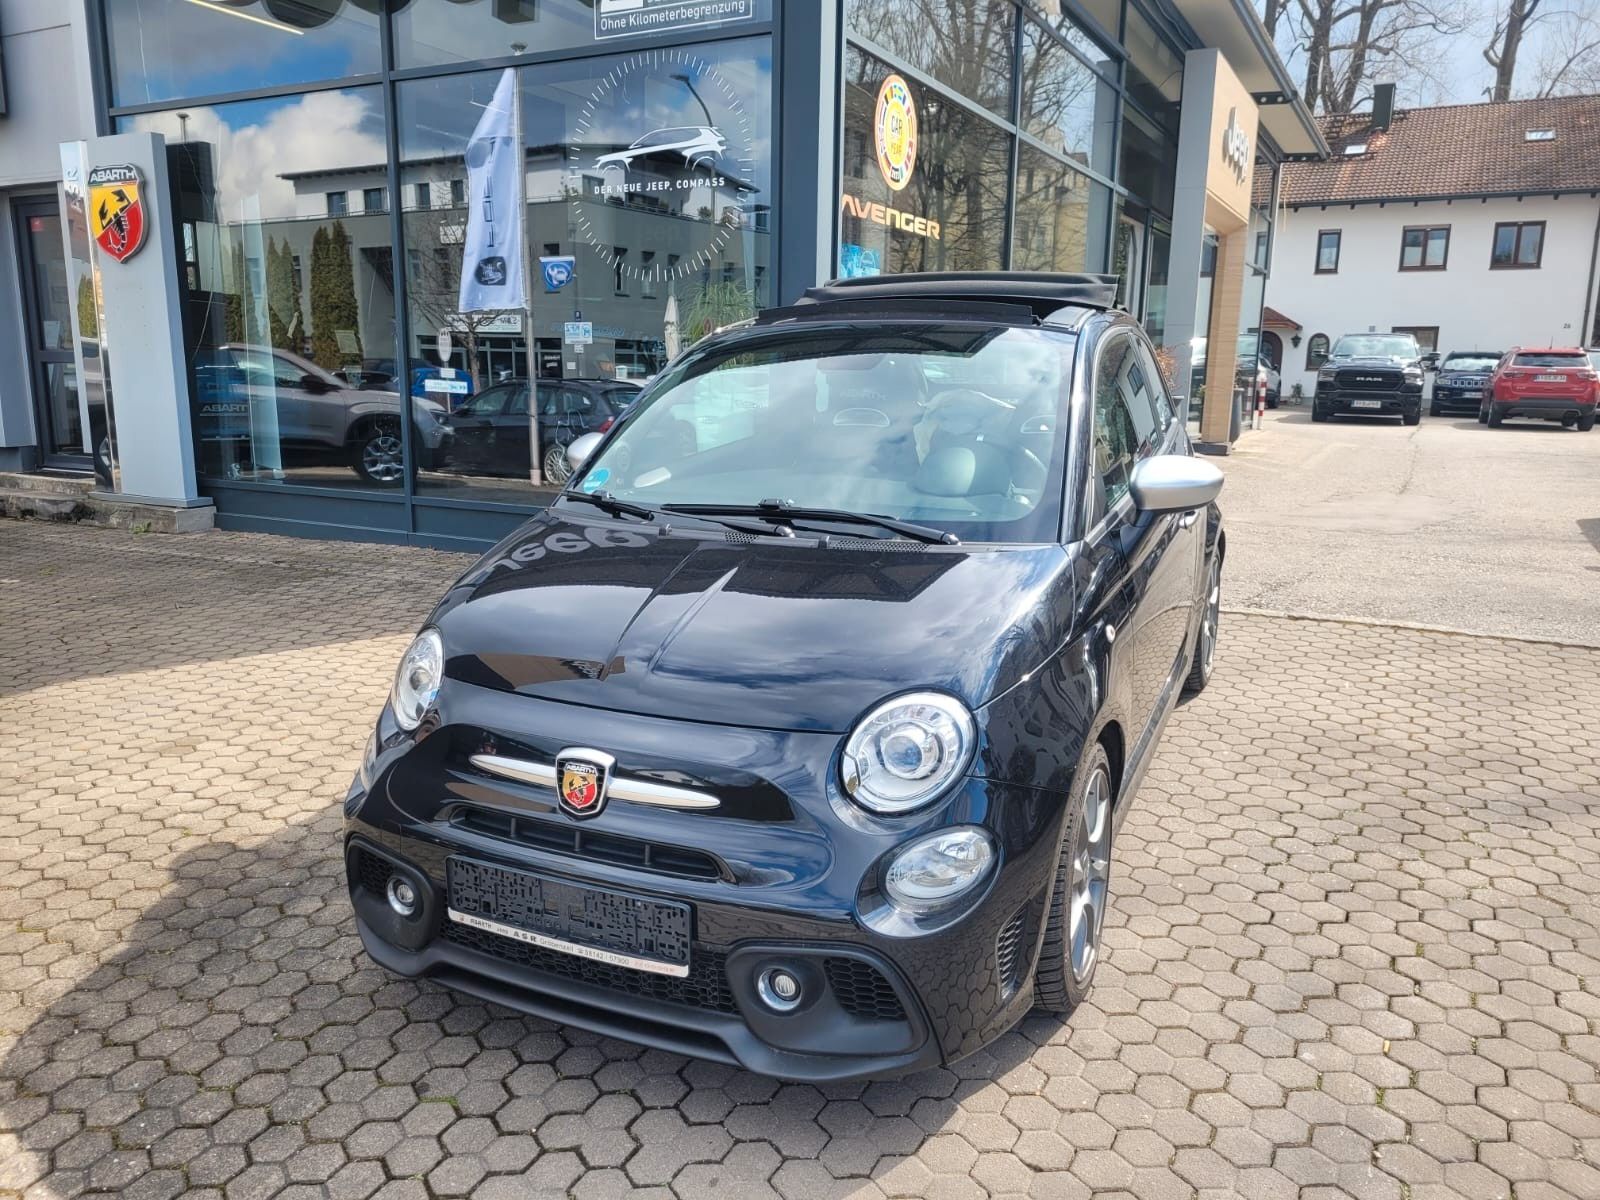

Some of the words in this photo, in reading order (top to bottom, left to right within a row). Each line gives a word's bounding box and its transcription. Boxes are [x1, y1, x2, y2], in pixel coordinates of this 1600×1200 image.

[600, 18, 626, 31] Ohne
[629, 1, 745, 27] Kilometerbegrenzung
[90, 169, 135, 183] ABARTH
[594, 185, 612, 195] DER
[616, 182, 642, 193] NEUE
[676, 177, 725, 189] COMPASS
[842, 193, 940, 240] AVENGER
